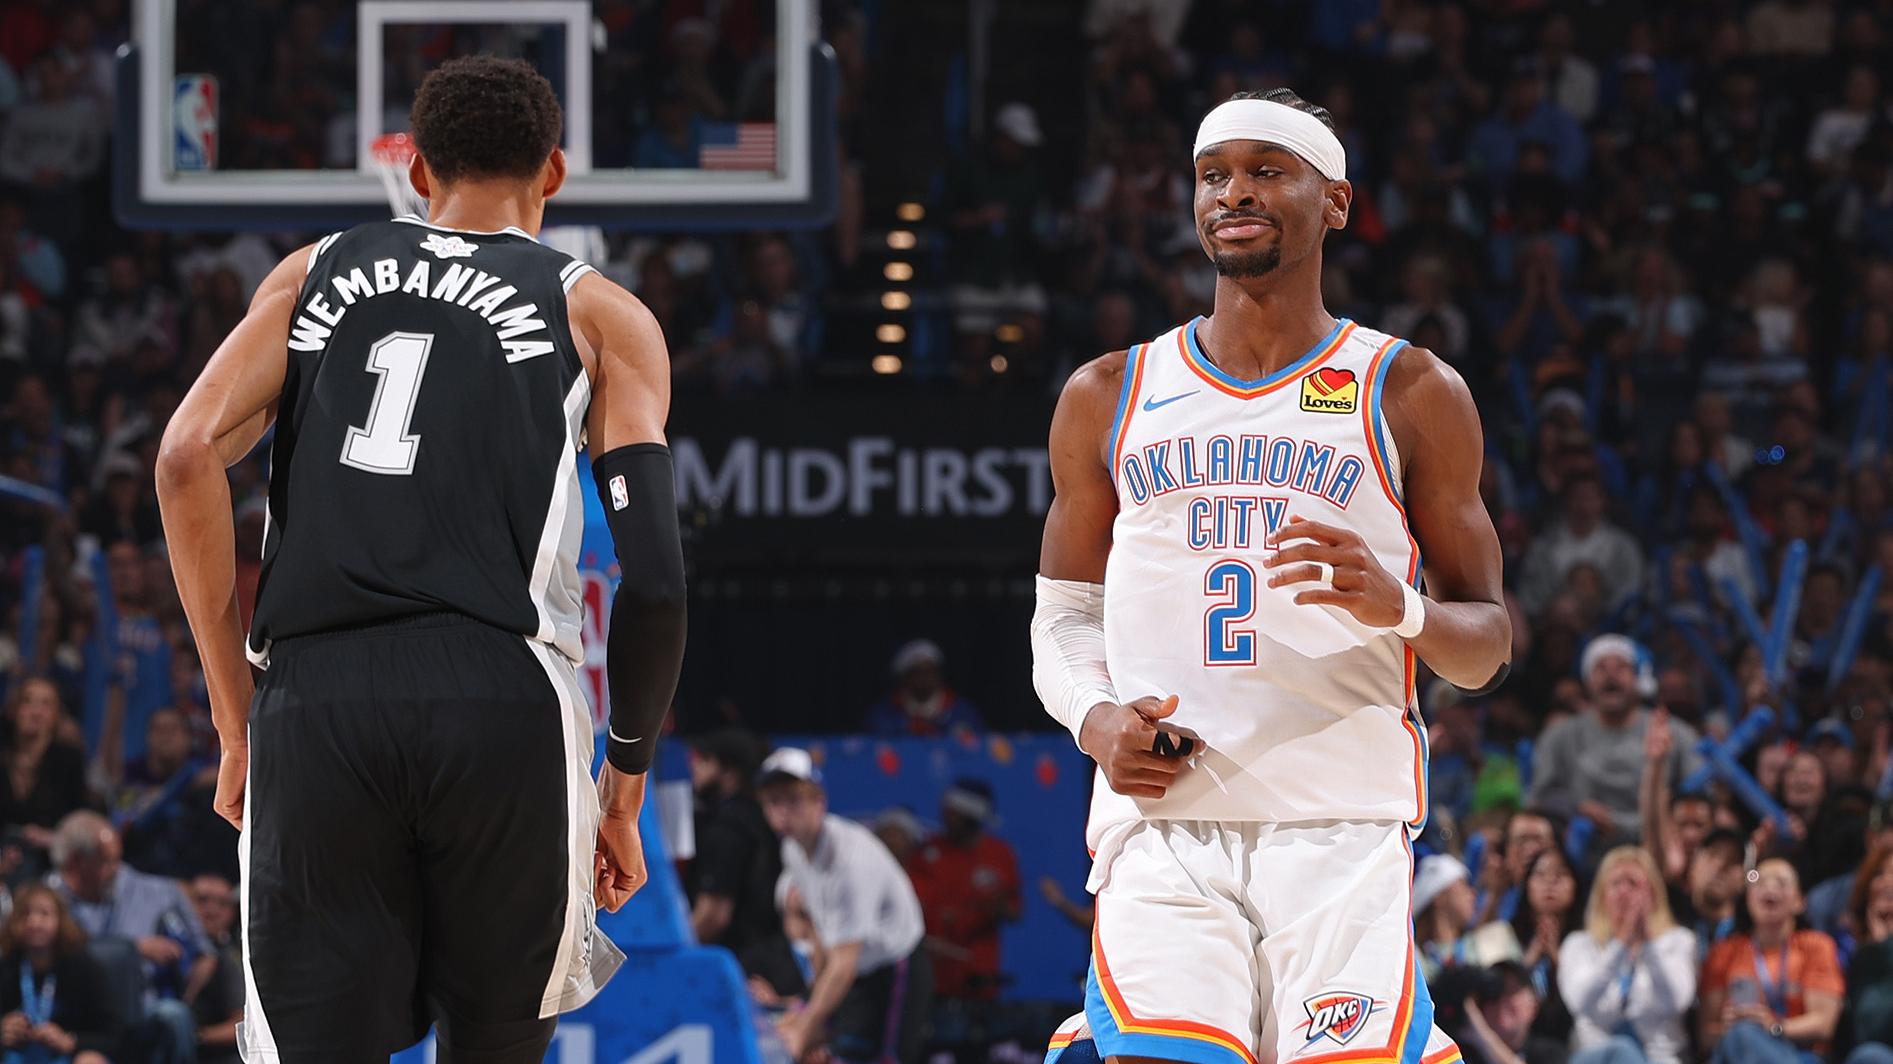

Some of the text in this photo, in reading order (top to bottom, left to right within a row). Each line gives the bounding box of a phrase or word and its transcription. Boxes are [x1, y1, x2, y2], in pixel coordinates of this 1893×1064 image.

[288, 258, 555, 364] WEMBANYAMA
[339, 331, 435, 476] 1
[1122, 434, 1365, 510] OKLAHOMA
[1187, 496, 1289, 550] CITY
[1204, 558, 1257, 666] 2
[1305, 998, 1360, 1040] OKC
